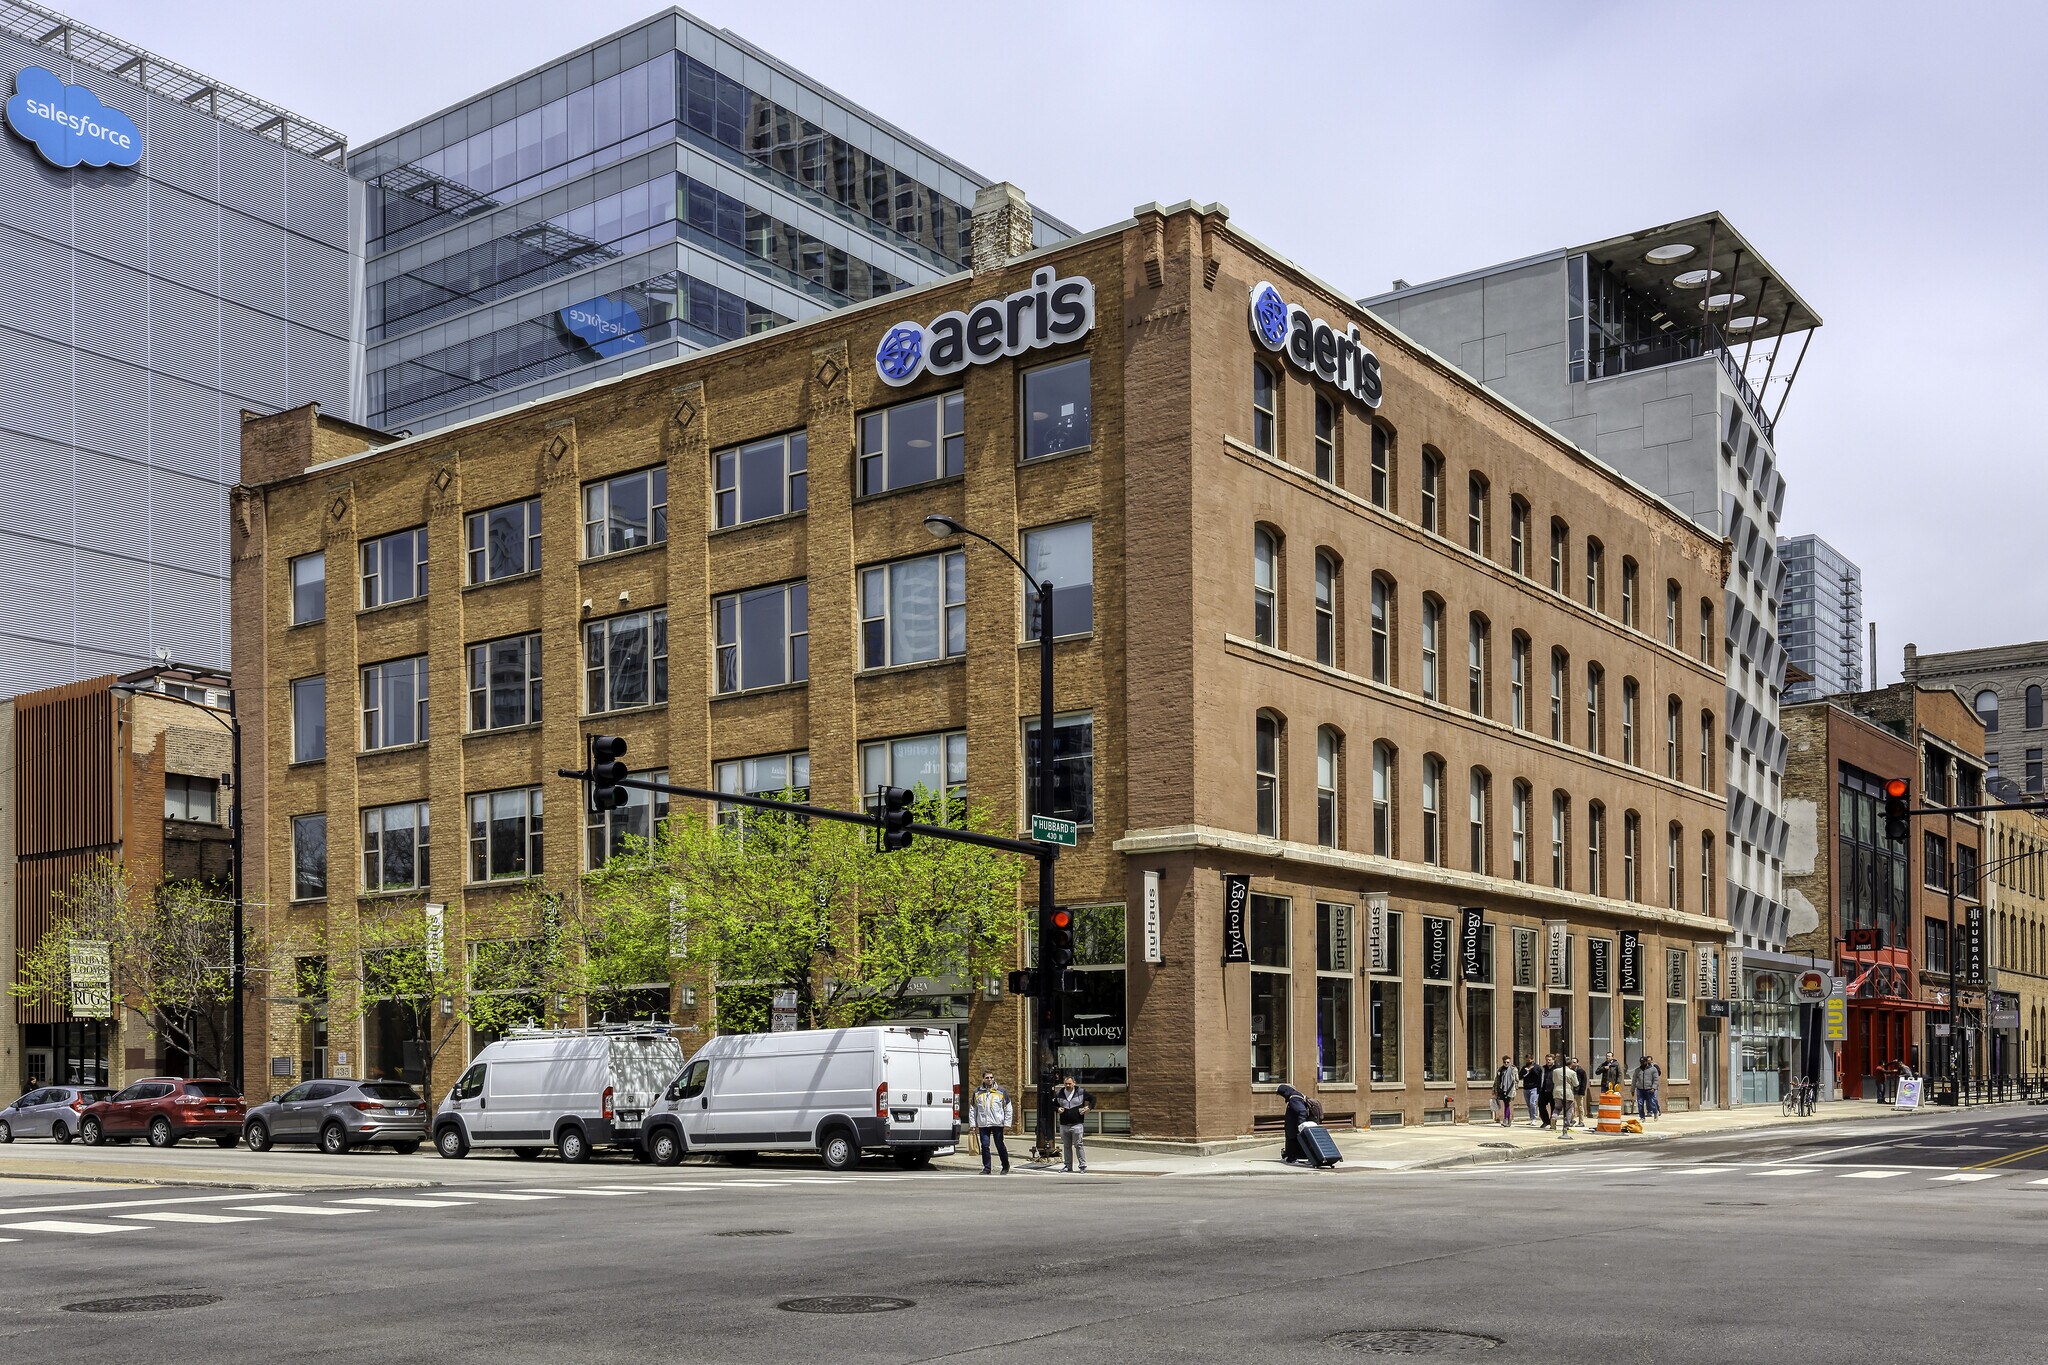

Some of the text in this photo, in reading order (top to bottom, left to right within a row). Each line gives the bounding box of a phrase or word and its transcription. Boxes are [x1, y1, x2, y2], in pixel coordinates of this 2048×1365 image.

[26, 99, 131, 149] salesforce
[929, 272, 1086, 368] aeris
[1291, 310, 1383, 400] aeris
[1038, 819, 1069, 834] HUBBARD
[1070, 826, 1075, 834] ST
[1046, 832, 1057, 840] 430
[1147, 888, 1156, 958] nuHaus
[1228, 880, 1246, 958] hydrology
[1369, 906, 1380, 968] nuHaus
[1464, 912, 1480, 974] hydrology
[1846, 929, 1878, 950] JOY
[1550, 932, 1559, 983] nuHaus
[1621, 934, 1636, 989] hydrology
[1971, 920, 1979, 978] HUBBARD
[74, 990, 108, 1005] RUGS
[1699, 953, 1707, 996] nuHaus
[1729, 956, 1737, 998] nuHaus
[1062, 1023, 1124, 1040] hydrology
[1827, 998, 1844, 1039] HUB
